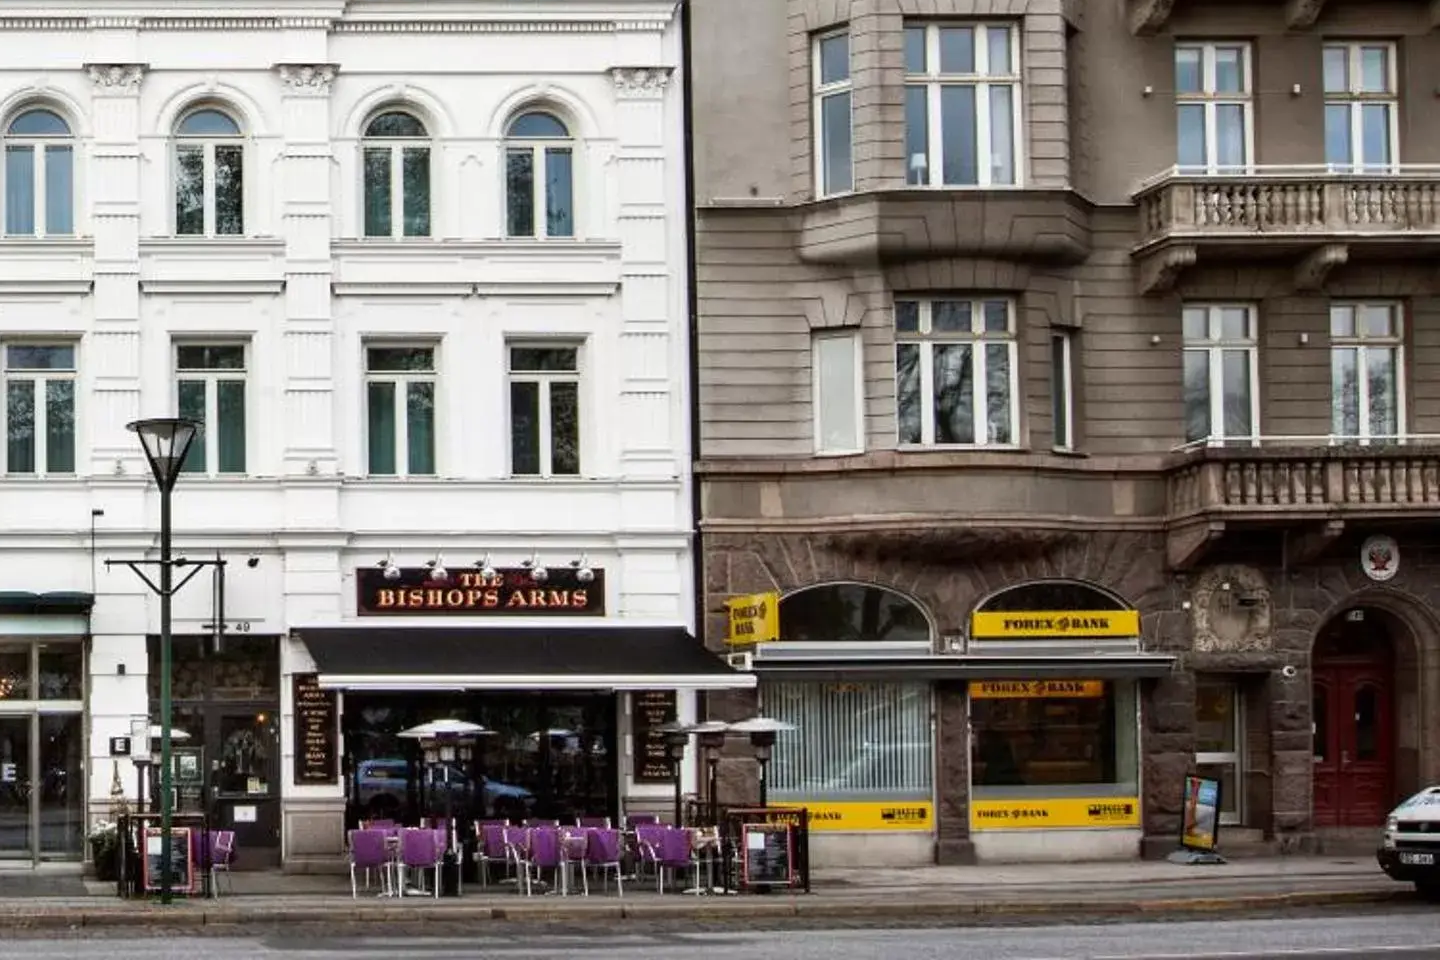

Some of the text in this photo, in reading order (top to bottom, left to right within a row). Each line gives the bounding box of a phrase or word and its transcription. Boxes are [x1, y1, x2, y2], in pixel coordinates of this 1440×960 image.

[461, 573, 504, 588] THE
[377, 590, 589, 607] BISHOPS ARMS
[235, 622, 251, 632] 49
[1003, 617, 1109, 631] FOREX BANK
[981, 682, 1085, 693] FOREX BANK
[1, 763, 17, 783] E
